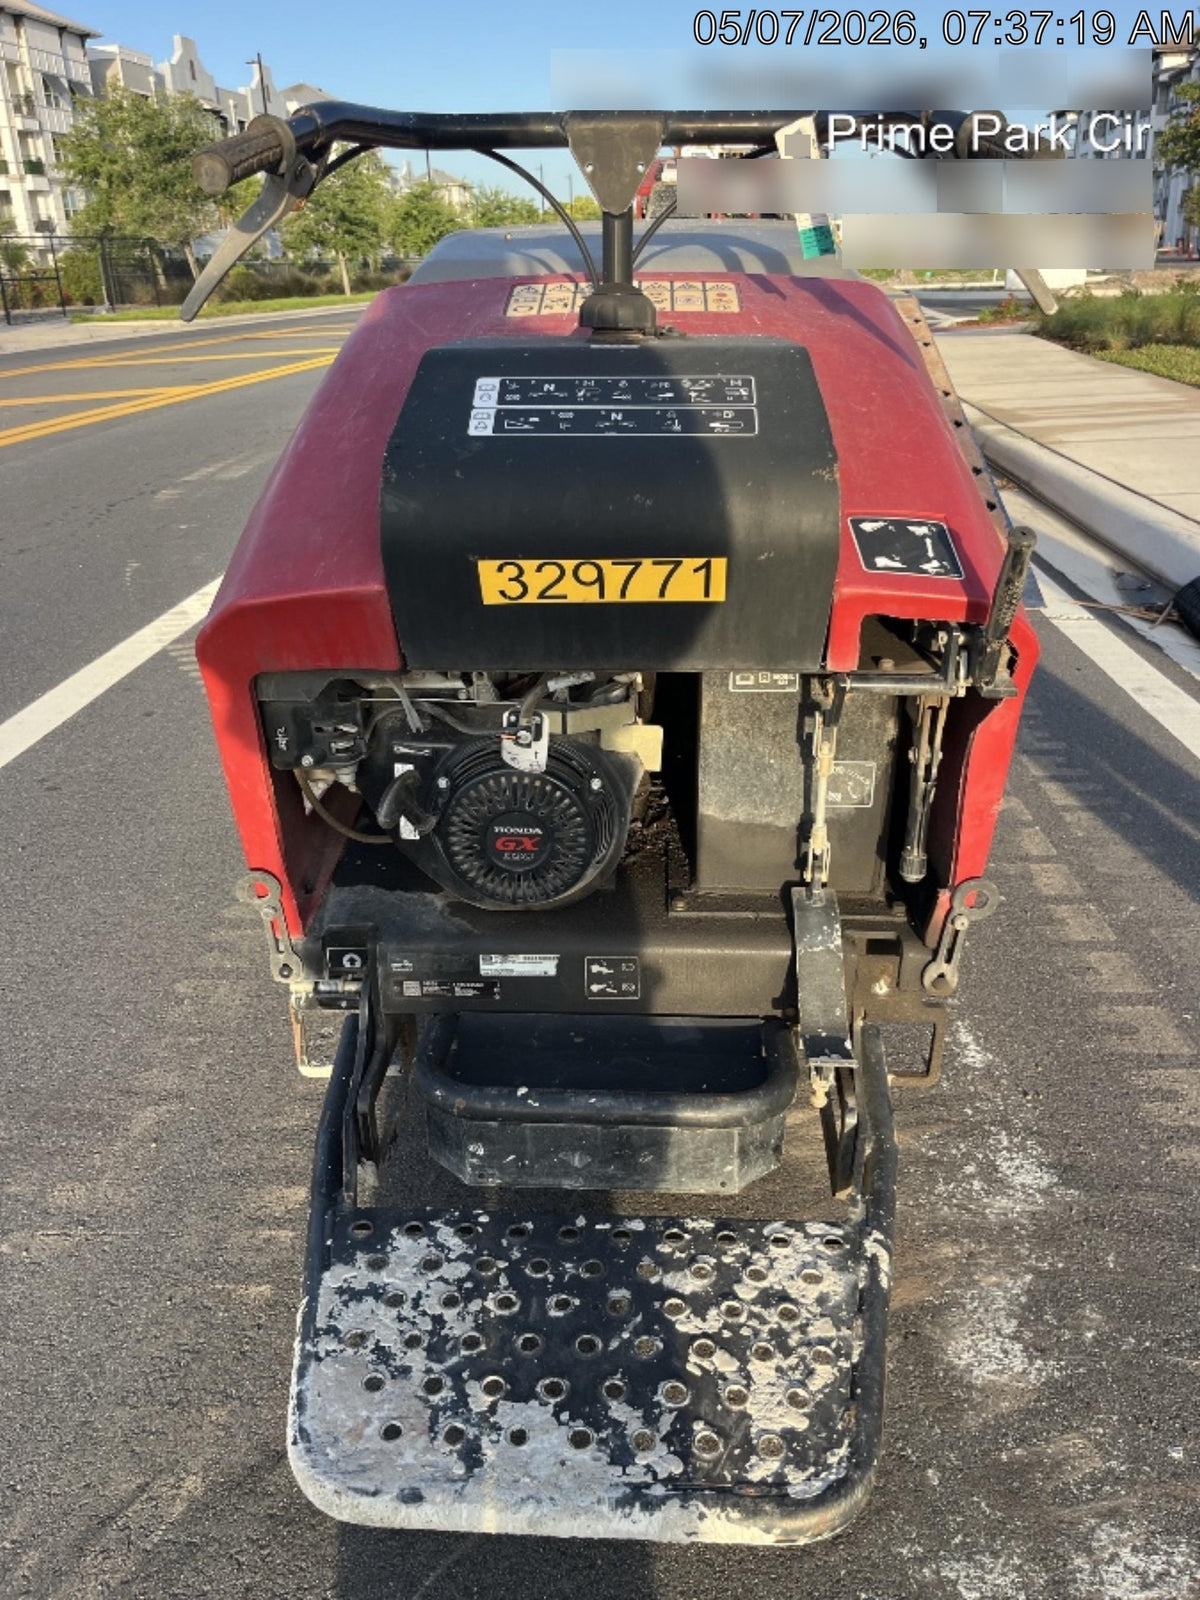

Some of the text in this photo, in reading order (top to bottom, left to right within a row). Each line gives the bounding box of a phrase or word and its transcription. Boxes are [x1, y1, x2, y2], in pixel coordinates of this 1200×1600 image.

[496, 559, 712, 601] 329771
[493, 825, 543, 835] HONDA
[495, 836, 541, 851] GX
